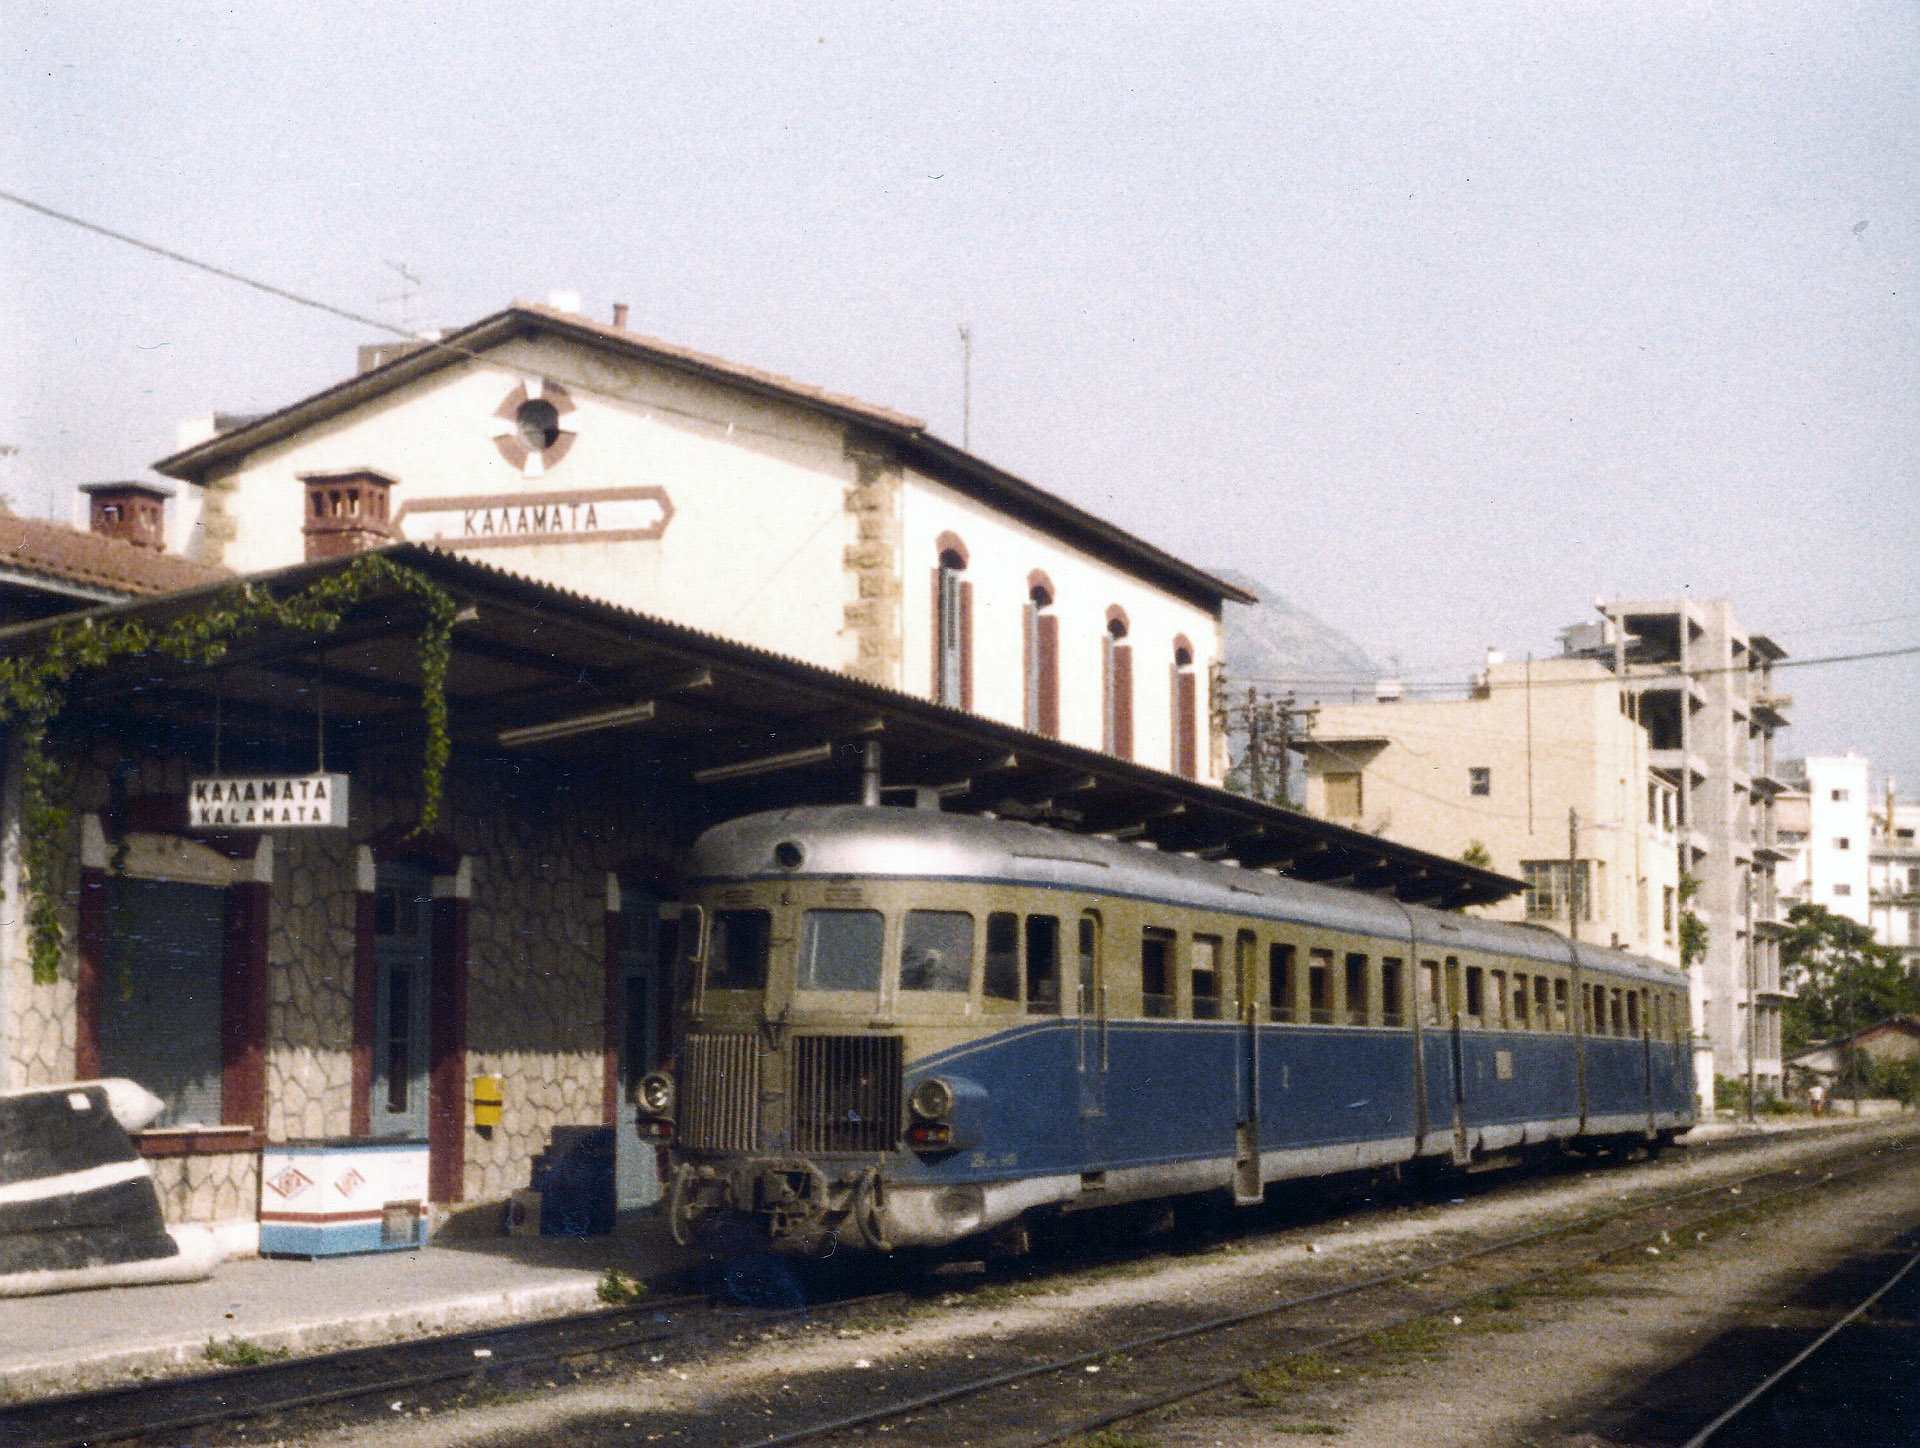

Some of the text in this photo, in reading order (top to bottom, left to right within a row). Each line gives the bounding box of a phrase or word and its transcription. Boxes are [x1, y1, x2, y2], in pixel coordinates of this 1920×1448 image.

[464, 504, 598, 535] ΚΑΛΑΜΑΤΑ
[196, 781, 326, 802] ΚΑΛΑΜΑΤΑ
[201, 807, 322, 823] KALAMATA
